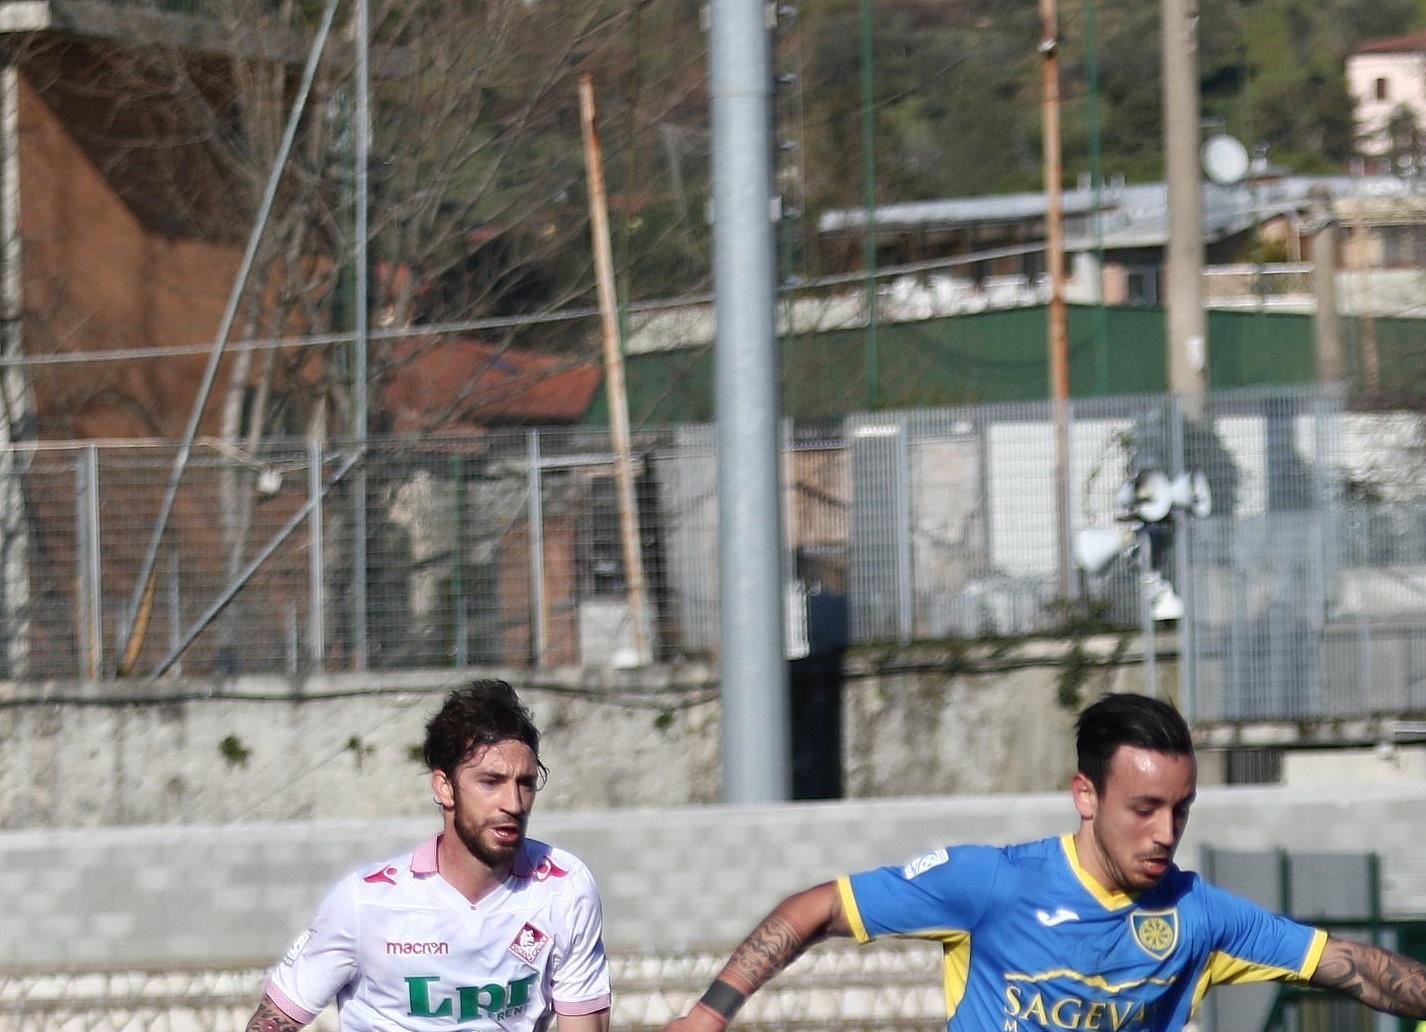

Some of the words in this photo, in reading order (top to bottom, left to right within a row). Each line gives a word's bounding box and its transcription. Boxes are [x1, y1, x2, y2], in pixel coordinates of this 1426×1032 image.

[386, 941, 449, 955] macron
[404, 972, 539, 1024] Lpr
[1004, 985, 1149, 1032] SAGEVA
